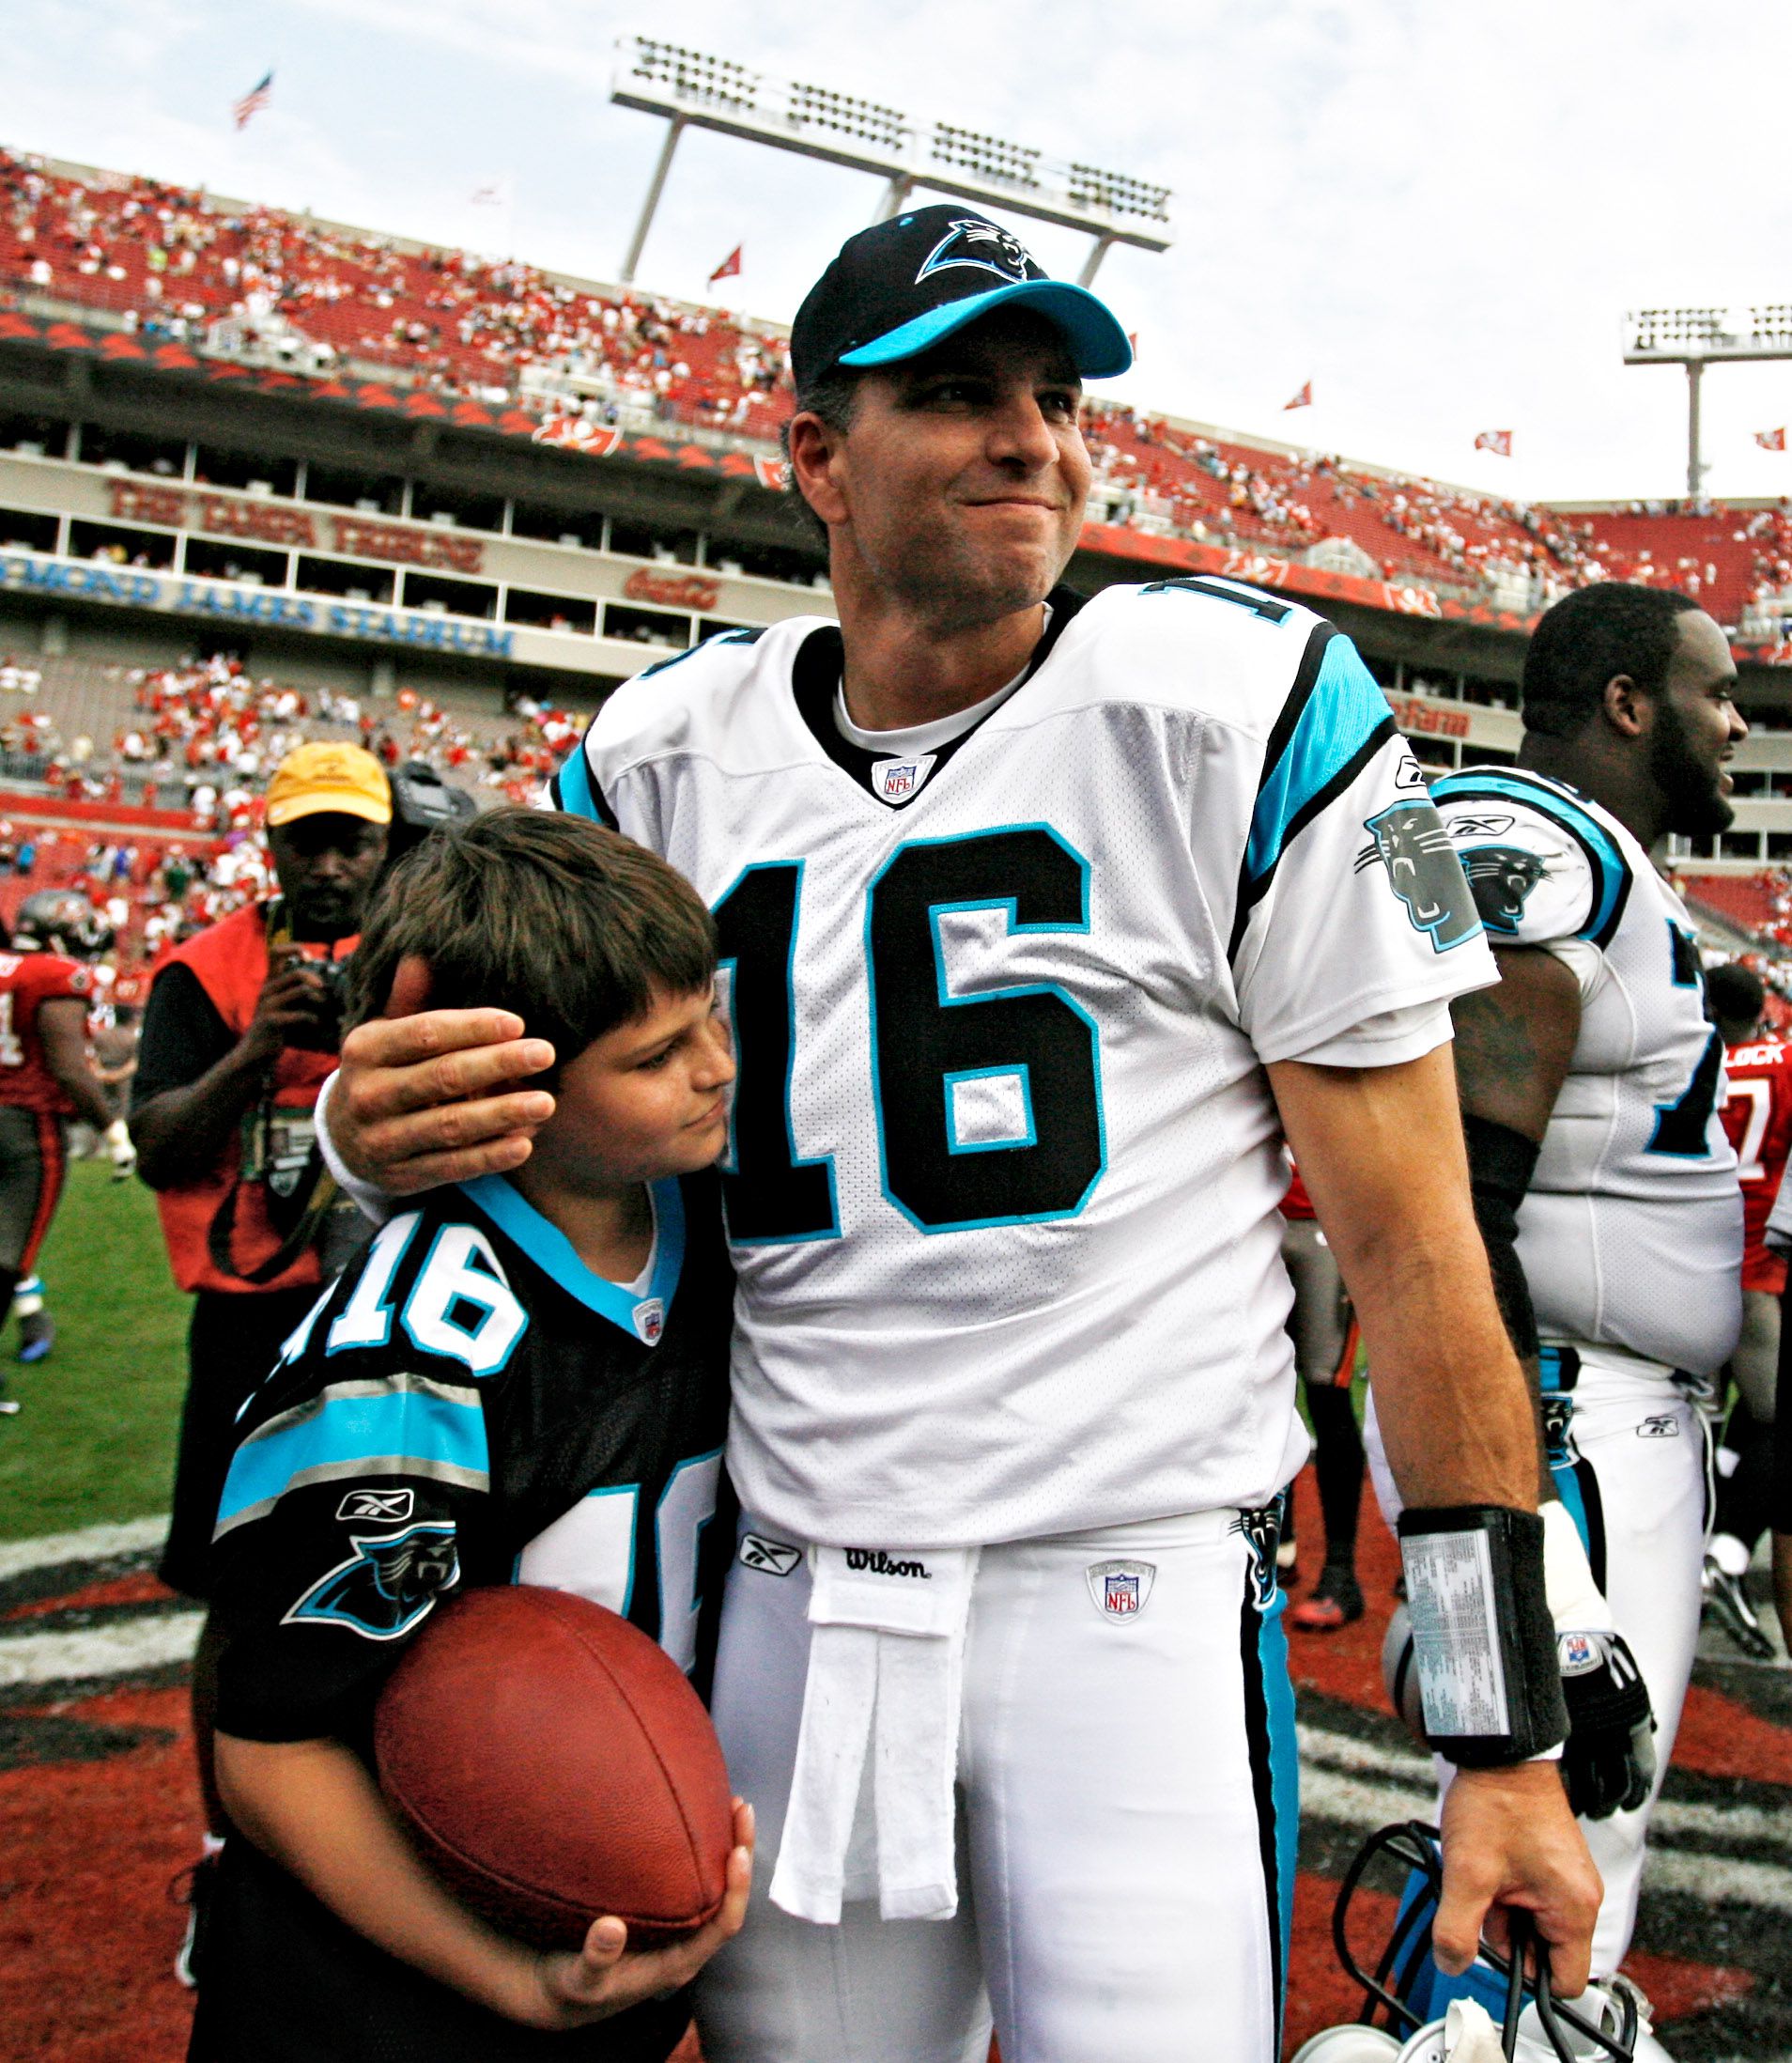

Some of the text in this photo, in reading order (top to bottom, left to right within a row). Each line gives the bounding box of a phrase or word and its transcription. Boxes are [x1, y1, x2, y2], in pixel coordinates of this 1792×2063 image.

[198, 491, 318, 551] TAMPA
[178, 581, 317, 628] JAMES
[330, 605, 515, 657] STADIUM
[885, 777, 911, 794] NFL
[709, 820, 1108, 1246] 16
[324, 1205, 531, 1378] 16
[842, 1546, 933, 1579] Wilson
[1107, 1590, 1136, 1613] NFL
